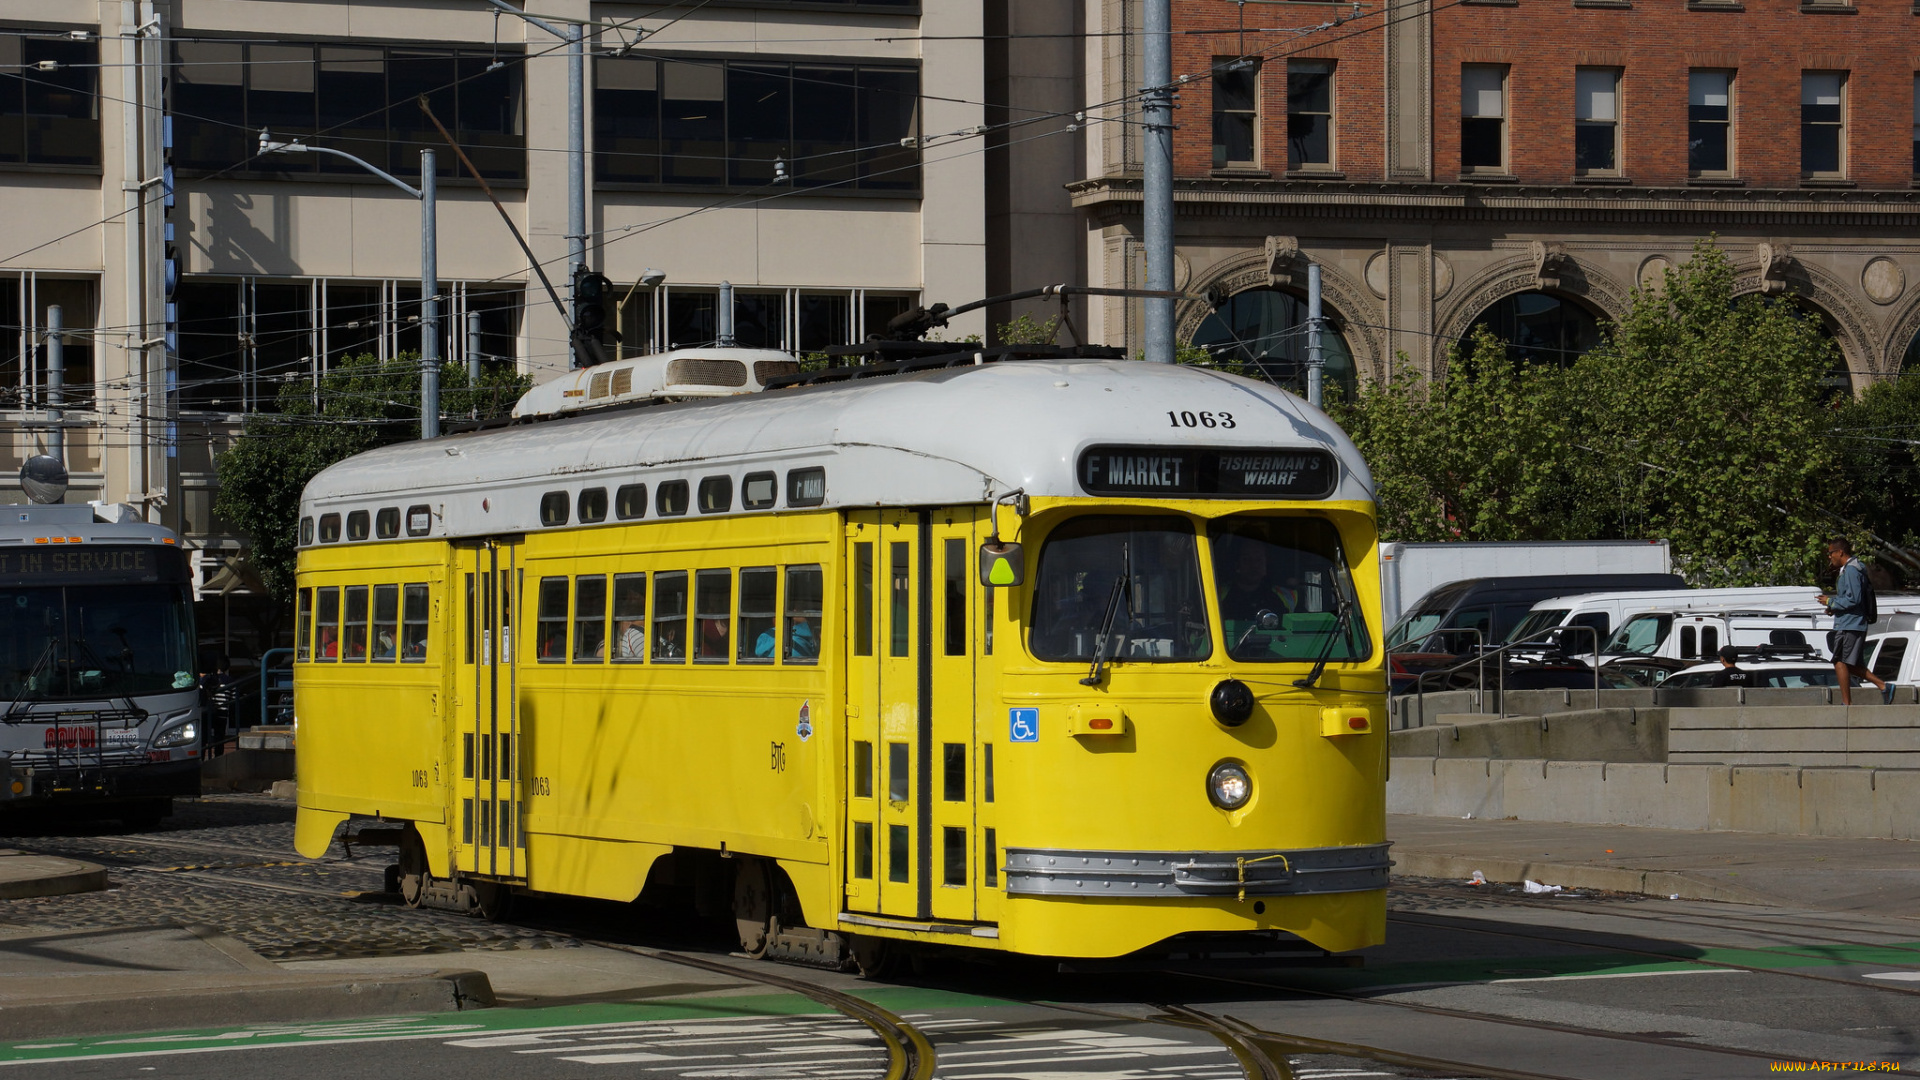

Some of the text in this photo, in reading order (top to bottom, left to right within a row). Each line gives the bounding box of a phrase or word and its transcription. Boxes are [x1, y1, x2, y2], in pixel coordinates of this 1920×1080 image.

[1166, 410, 1237, 429] 1063
[1086, 455, 1183, 486] F MARKET
[1218, 456, 1321, 471] FISHERMAN'S
[1243, 471, 1298, 486] WHARF
[20, 553, 43, 573] IN
[52, 550, 146, 572] SERVICE
[411, 769, 429, 788] 1063
[530, 776, 551, 796] 1063
